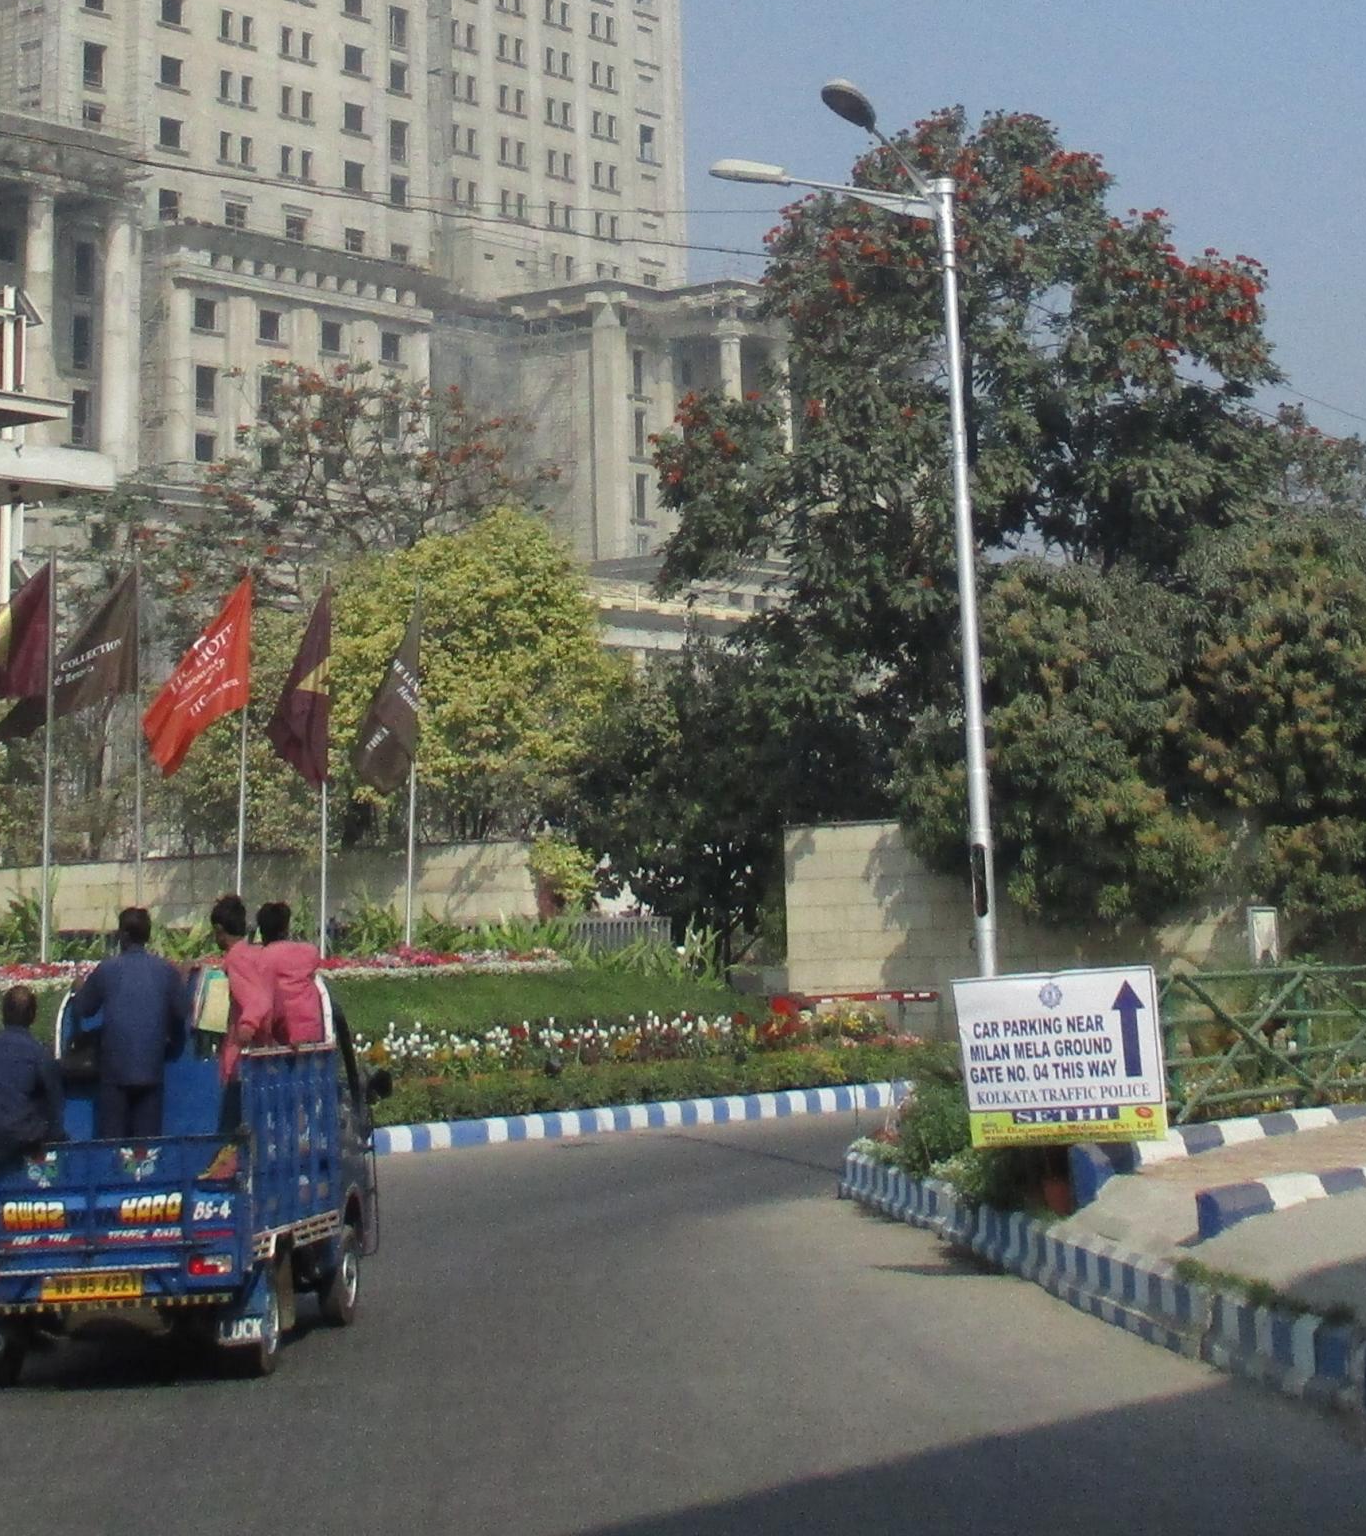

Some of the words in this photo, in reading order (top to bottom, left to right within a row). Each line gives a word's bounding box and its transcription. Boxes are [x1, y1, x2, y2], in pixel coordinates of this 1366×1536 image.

[60, 639, 122, 671] COLLECTION
[973, 1022, 999, 1039] CAR
[1003, 1017, 1063, 1037] PARKING
[1067, 1015, 1104, 1034] NEAR
[970, 1043, 1010, 1062] MILAN
[1014, 1041, 1051, 1059] MELA
[1054, 1037, 1112, 1057] GROUND
[970, 1065, 1003, 1084] GATE
[1007, 1065, 1030, 1083] NO.
[1034, 1064, 1049, 1081] 04
[1052, 1062, 1084, 1080] THIS
[1087, 1059, 1117, 1078] WAY
[976, 1089, 1037, 1105] KOLKATA
[1039, 1085, 1096, 1102] TRAFFIC
[1100, 1082, 1151, 1099] POLICE
[1016, 1107, 1109, 1124] SETHI
[192, 1200, 232, 1221] BS-4
[220, 1318, 263, 1341] LUCK
